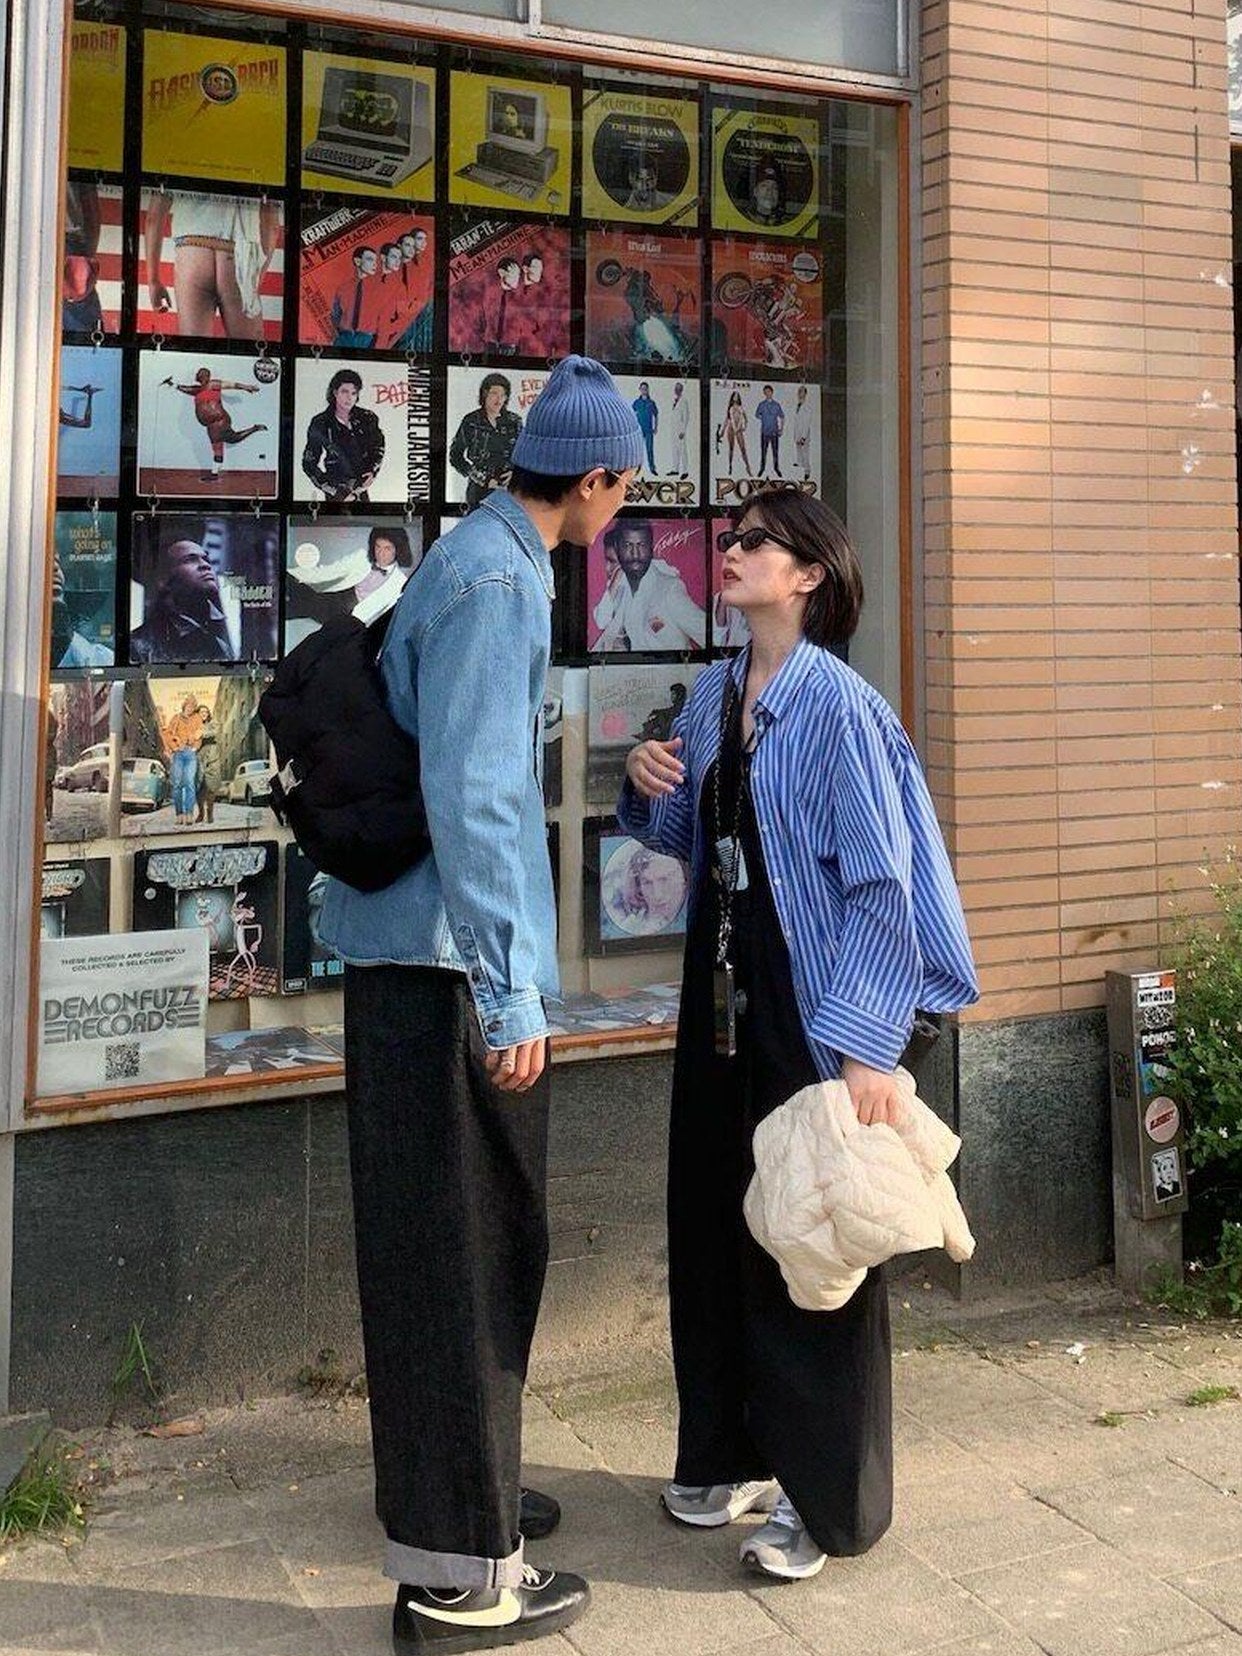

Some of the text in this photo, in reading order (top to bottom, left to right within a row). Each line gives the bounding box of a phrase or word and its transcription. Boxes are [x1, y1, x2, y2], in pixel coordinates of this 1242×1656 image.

[300, 206, 355, 246] KRAFTWERK
[408, 364, 430, 502] MICHAEL JACKSON
[61, 948, 187, 966] THESE RECORDS ARE CAREFULLY
[71, 961, 118, 972] COLLECTED
[126, 957, 165, 967] SELECTED
[44, 985, 200, 1022] DEMONFUZZ
[66, 1008, 180, 1042] RECORDS
